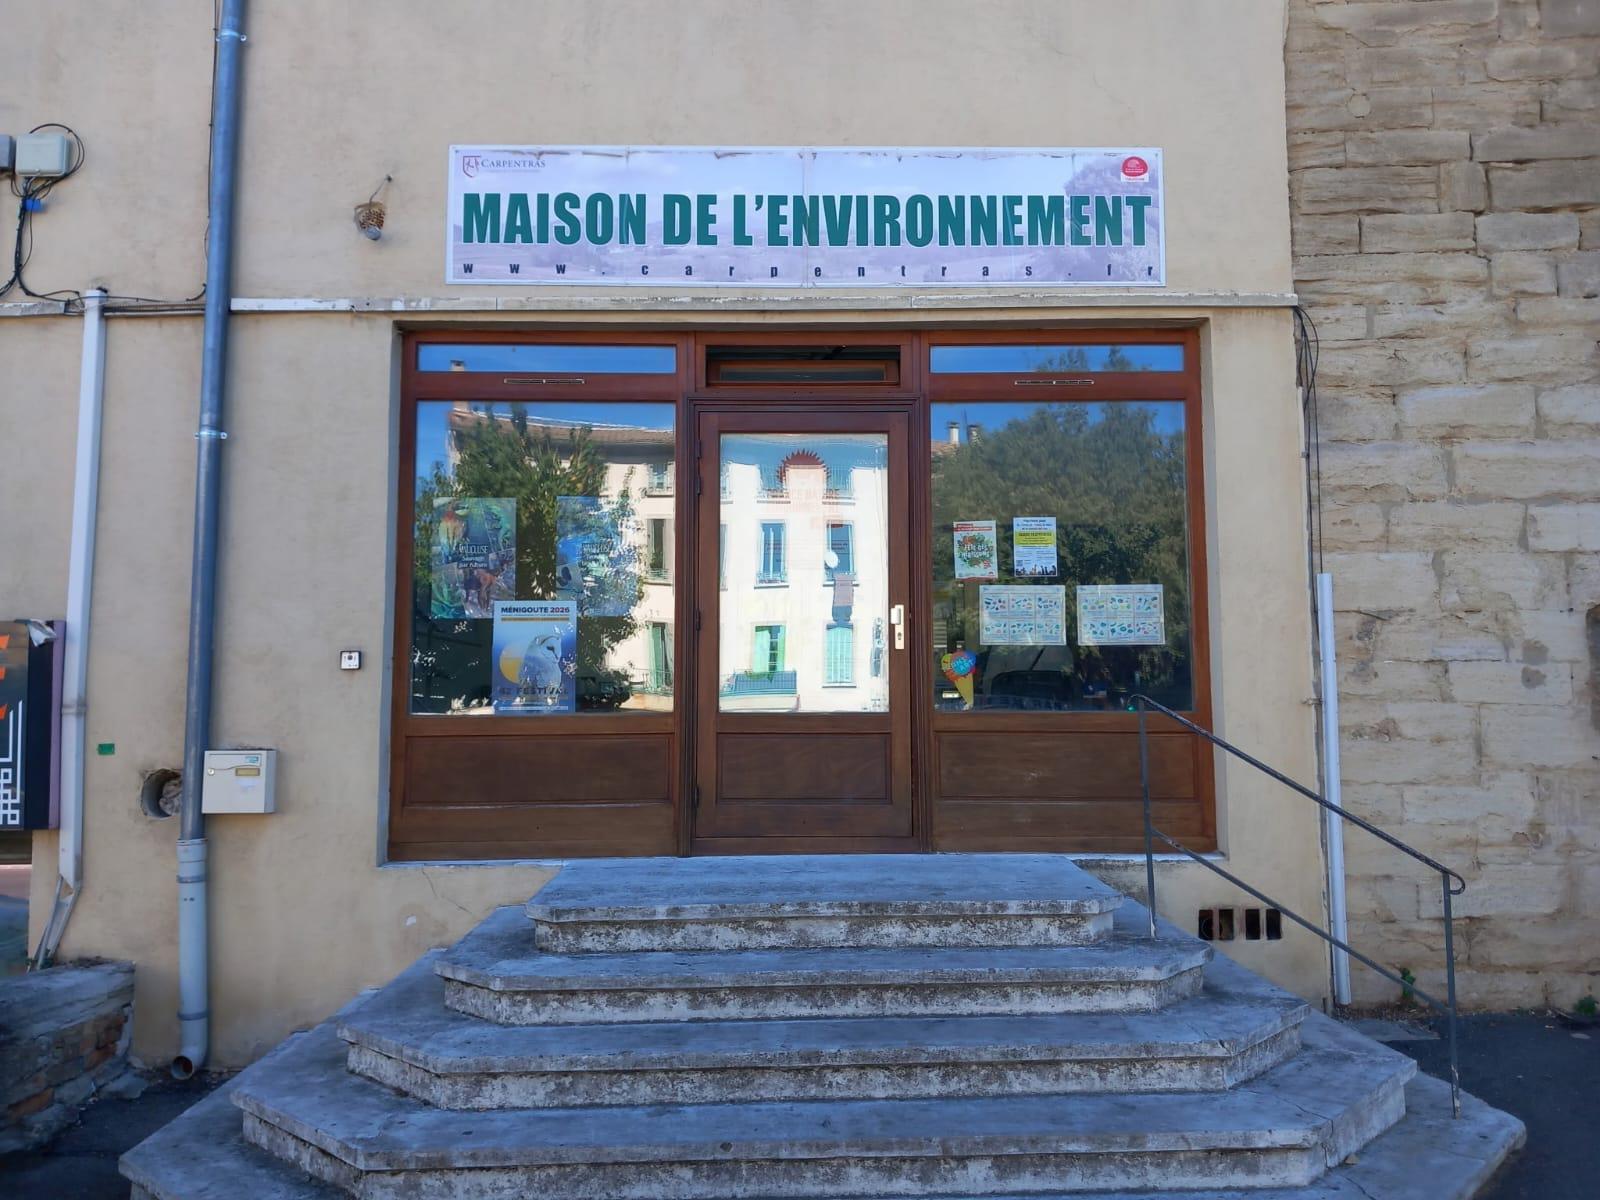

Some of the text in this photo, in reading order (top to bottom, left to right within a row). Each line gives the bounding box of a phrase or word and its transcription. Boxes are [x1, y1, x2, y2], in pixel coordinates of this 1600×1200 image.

[462, 192, 1152, 247] MAISON DE L’ENVIRONNEMENT
